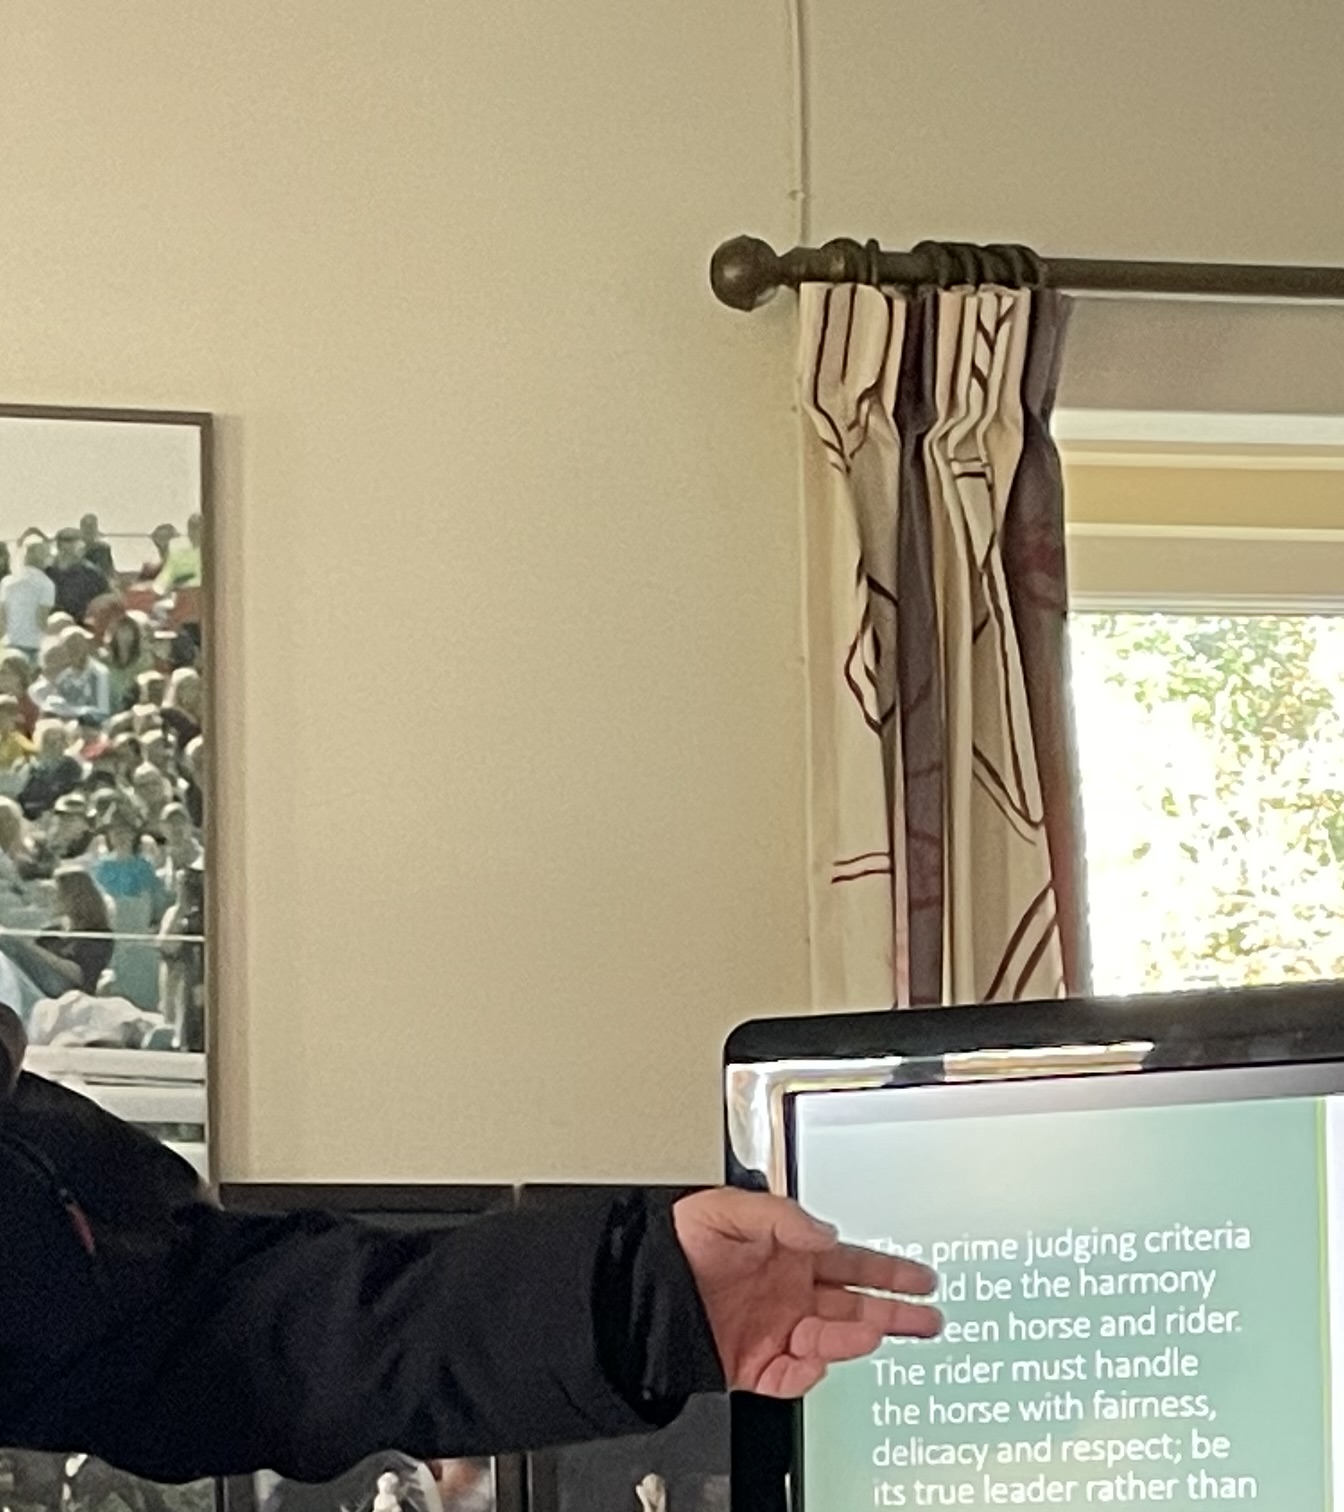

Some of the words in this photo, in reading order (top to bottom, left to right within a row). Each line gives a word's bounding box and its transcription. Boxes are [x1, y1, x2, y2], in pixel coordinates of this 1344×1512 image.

[932, 1233, 1019, 1272] prime
[1024, 1229, 1137, 1266] judging
[1143, 1219, 1251, 1253] criteria
[975, 1271, 1012, 1301] be
[1020, 1268, 1071, 1300] the
[1079, 1267, 1217, 1300] harmony
[1008, 1310, 1091, 1341] horse
[1099, 1305, 1156, 1337] and
[1165, 1303, 1243, 1335] rider.
[867, 1355, 926, 1387] The
[933, 1353, 1005, 1385] rider
[1011, 1353, 1088, 1382] must
[1094, 1346, 1199, 1380] handle
[871, 1396, 921, 1427] the
[928, 1394, 1011, 1425] horse
[1017, 1390, 1084, 1422] with
[1092, 1389, 1217, 1422] fairness,
[871, 1436, 990, 1472] delicacy
[996, 1432, 1052, 1464] and
[1061, 1433, 1182, 1469] respect;
[1191, 1427, 1231, 1459] be
[873, 1481, 906, 1507] its
[913, 1479, 975, 1506] true
[983, 1473, 1079, 1504] leader
[1086, 1470, 1180, 1502] rather
[1186, 1468, 1257, 1500] than
